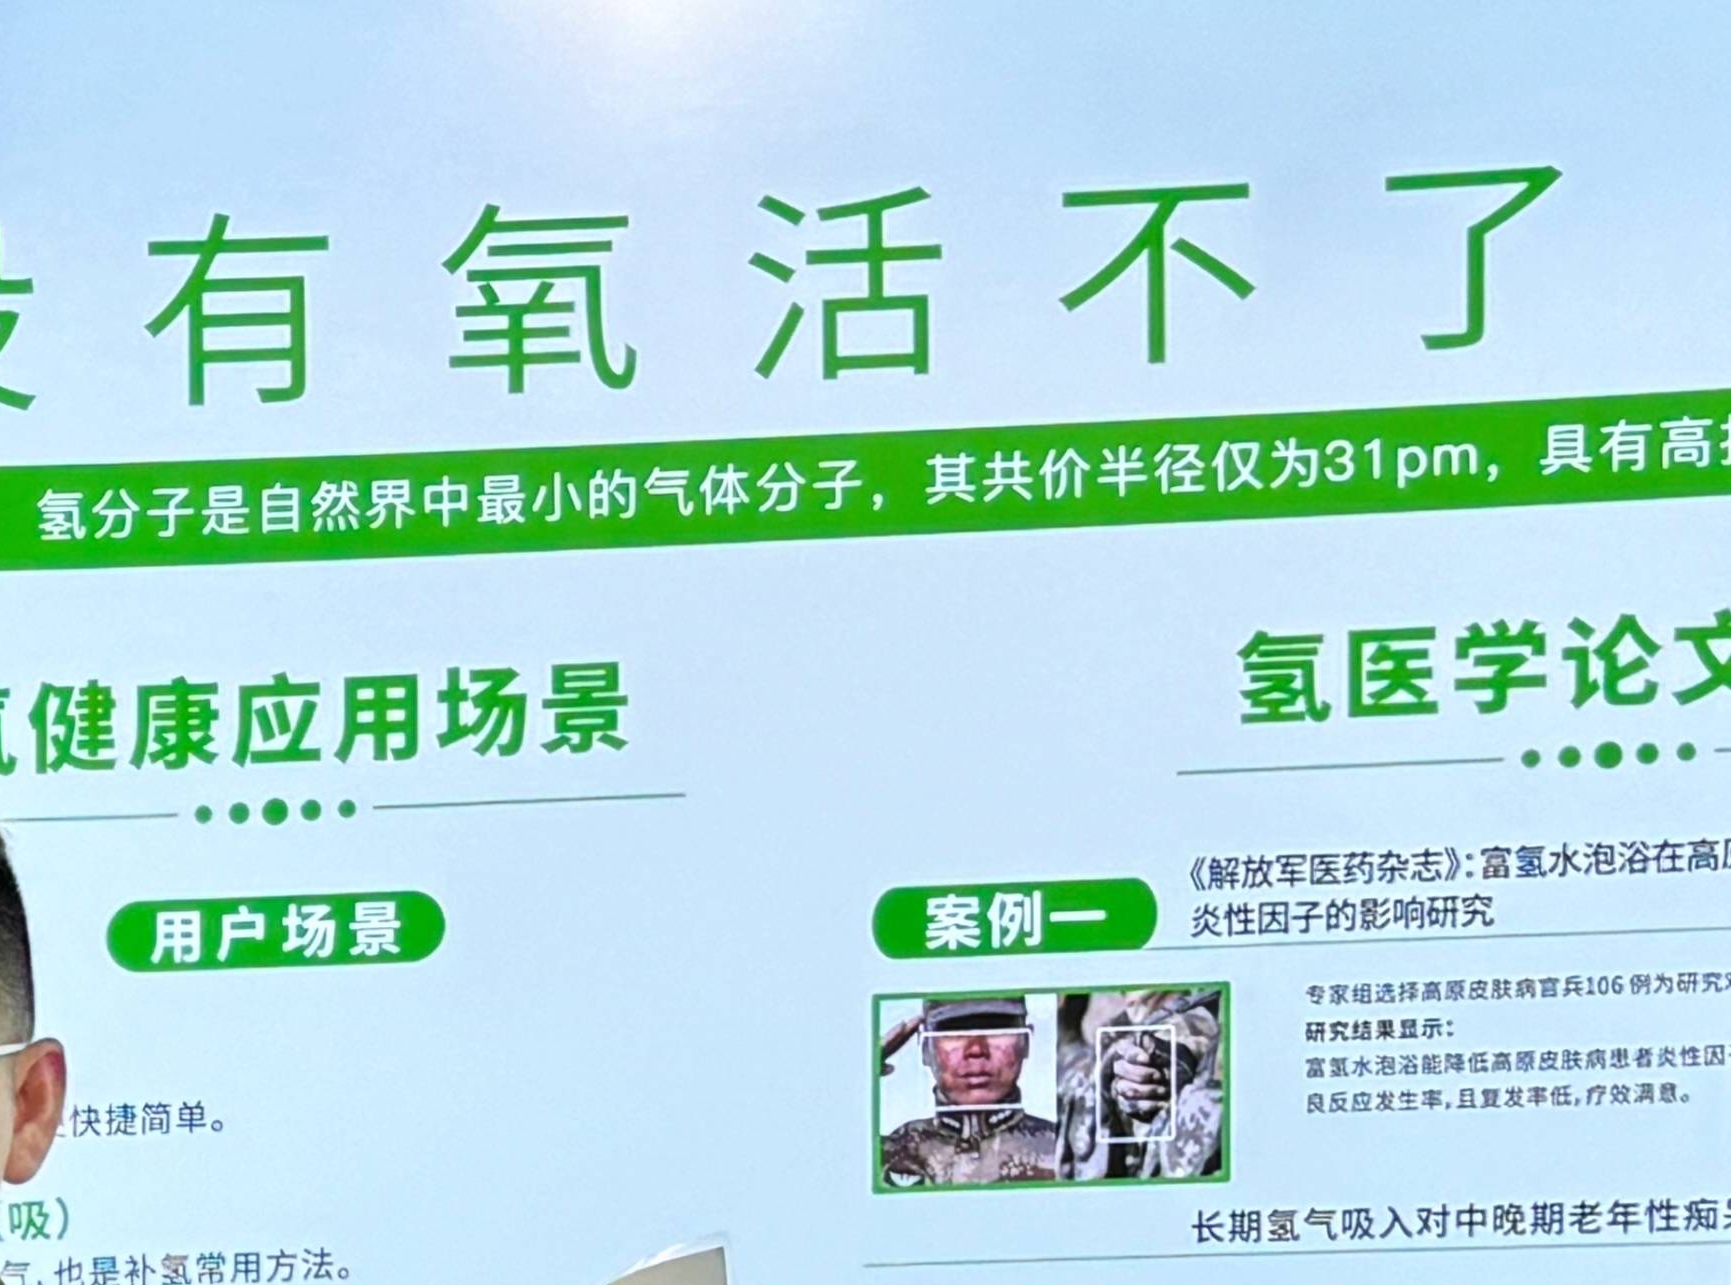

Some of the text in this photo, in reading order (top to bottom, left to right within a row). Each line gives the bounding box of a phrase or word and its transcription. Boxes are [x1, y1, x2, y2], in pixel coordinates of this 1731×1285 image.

[36, 415, 1731, 542] 氢分子是自然界中最小的气体分子，其共价半径仅为31pm，具有高
[1236, 607, 1731, 725] 氢医学论文
[150, 901, 402, 964] 用户场景
[925, 890, 1107, 949] 案例一
[1191, 894, 1494, 937] 炎性因子的影响研究
[58, 1101, 226, 1138] 快捷简单。
